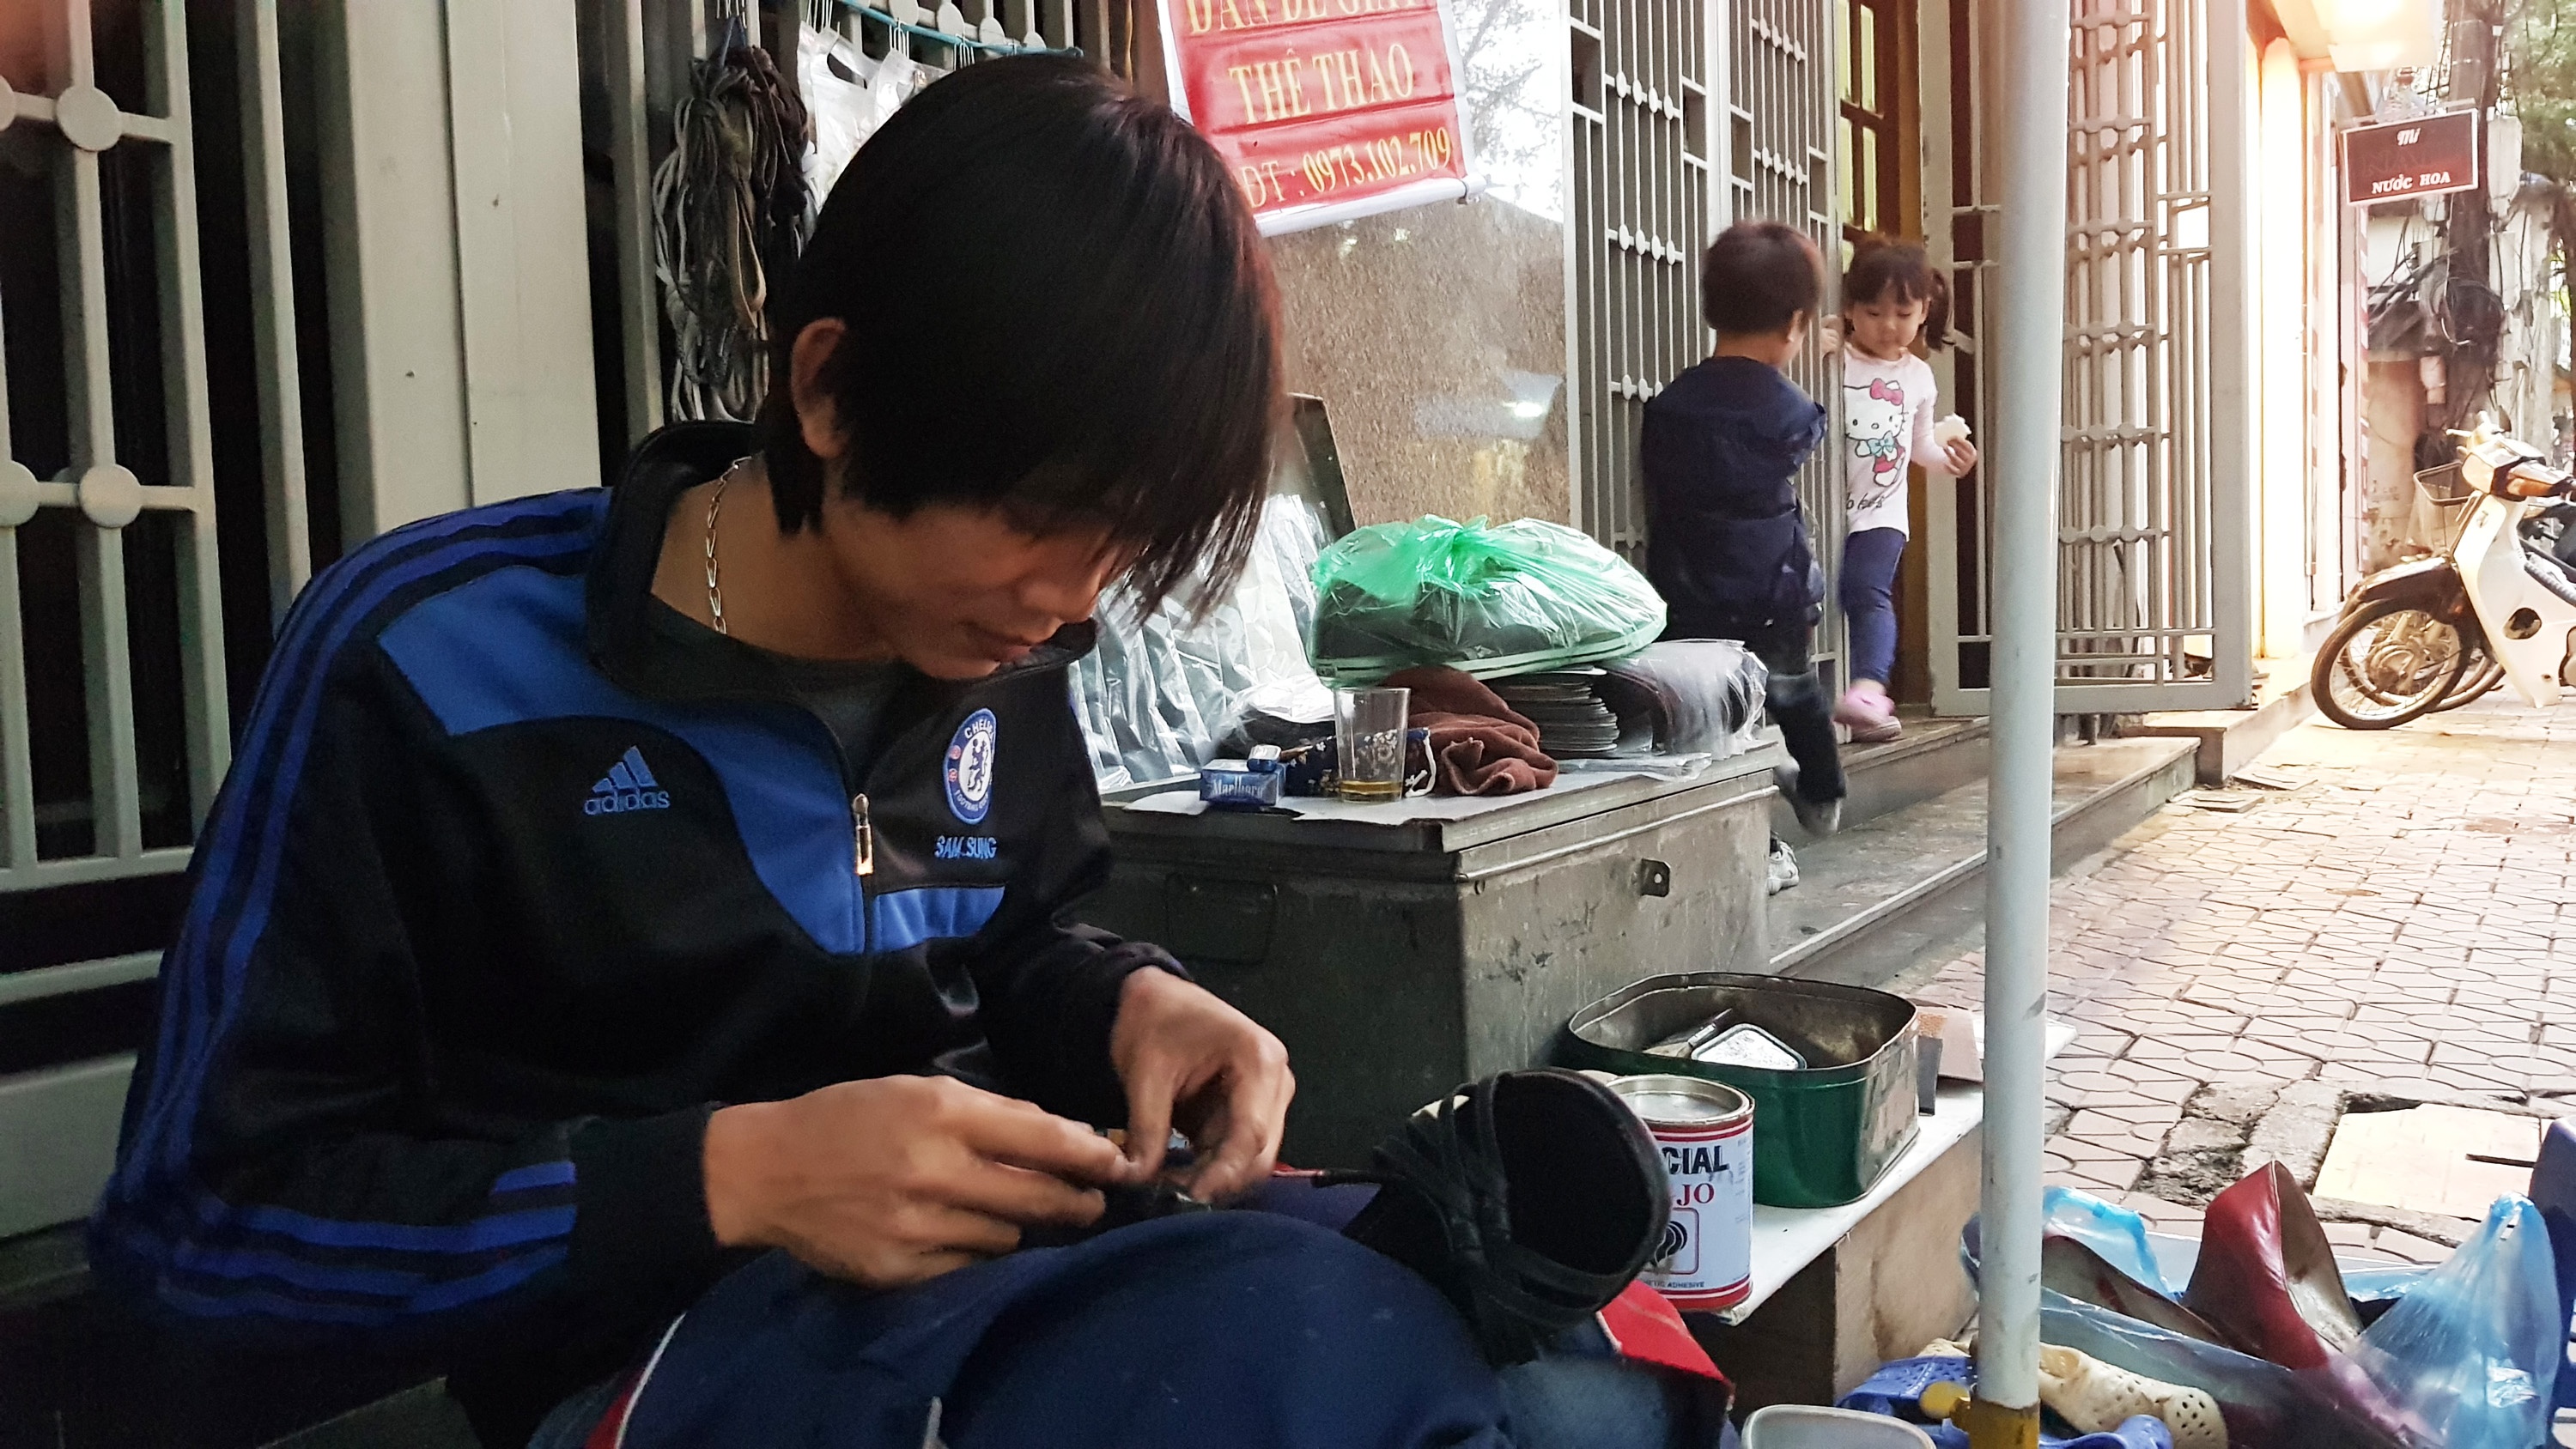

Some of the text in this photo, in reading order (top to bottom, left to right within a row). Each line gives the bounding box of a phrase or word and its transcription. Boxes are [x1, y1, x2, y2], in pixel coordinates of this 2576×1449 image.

[1312, 44, 1413, 112] THAO
[1303, 127, 1452, 193] 0973.102.709
[2419, 171, 2451, 186] HOA
[1212, 775, 1263, 797] Marlboro
[585, 789, 670, 815] adidas
